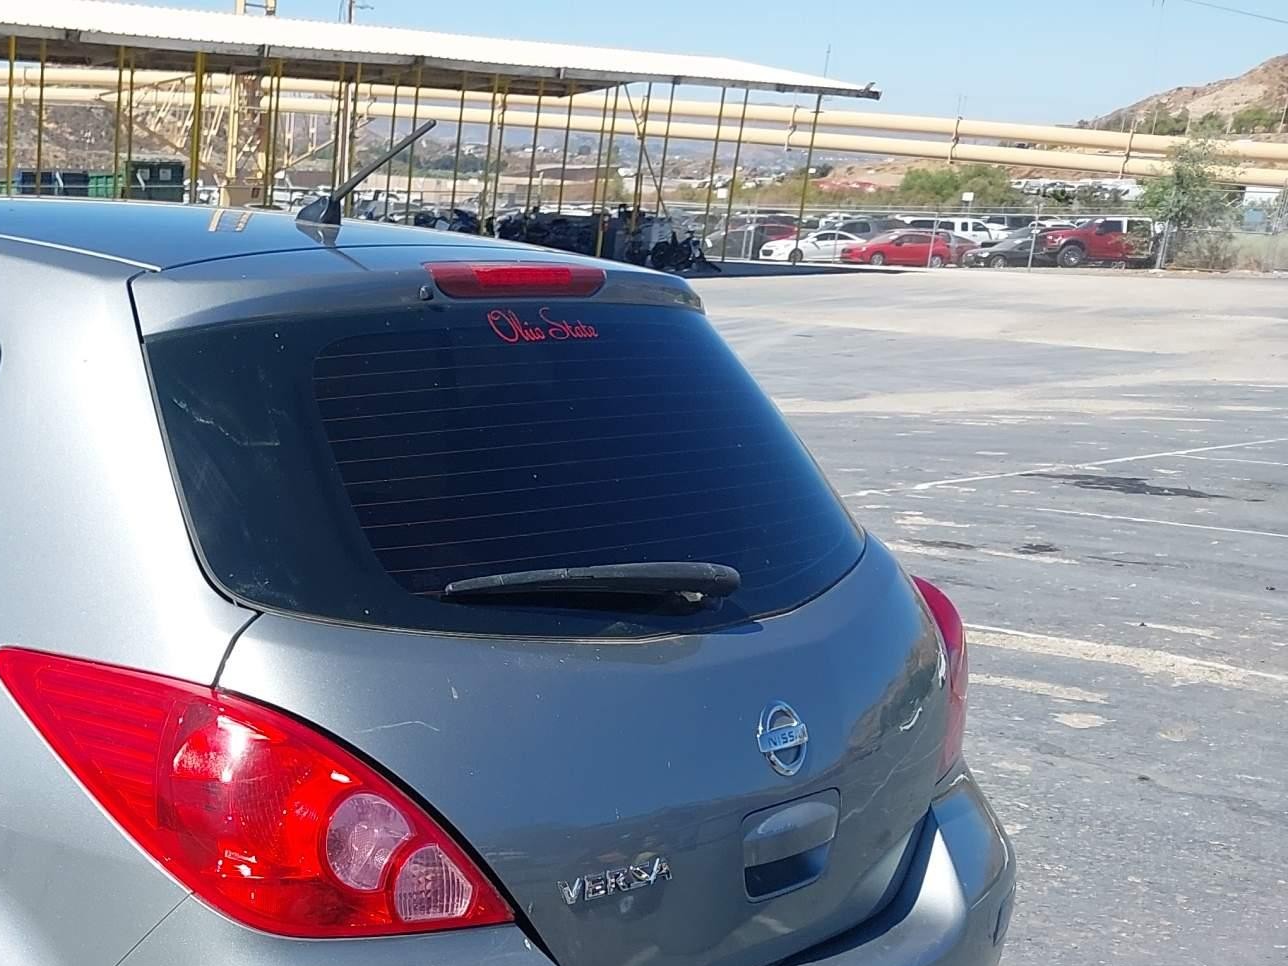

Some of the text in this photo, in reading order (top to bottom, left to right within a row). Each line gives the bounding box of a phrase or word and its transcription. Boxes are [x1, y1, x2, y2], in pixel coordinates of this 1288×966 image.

[487, 306, 598, 343] Ohio State
[557, 857, 672, 904] VERSA
